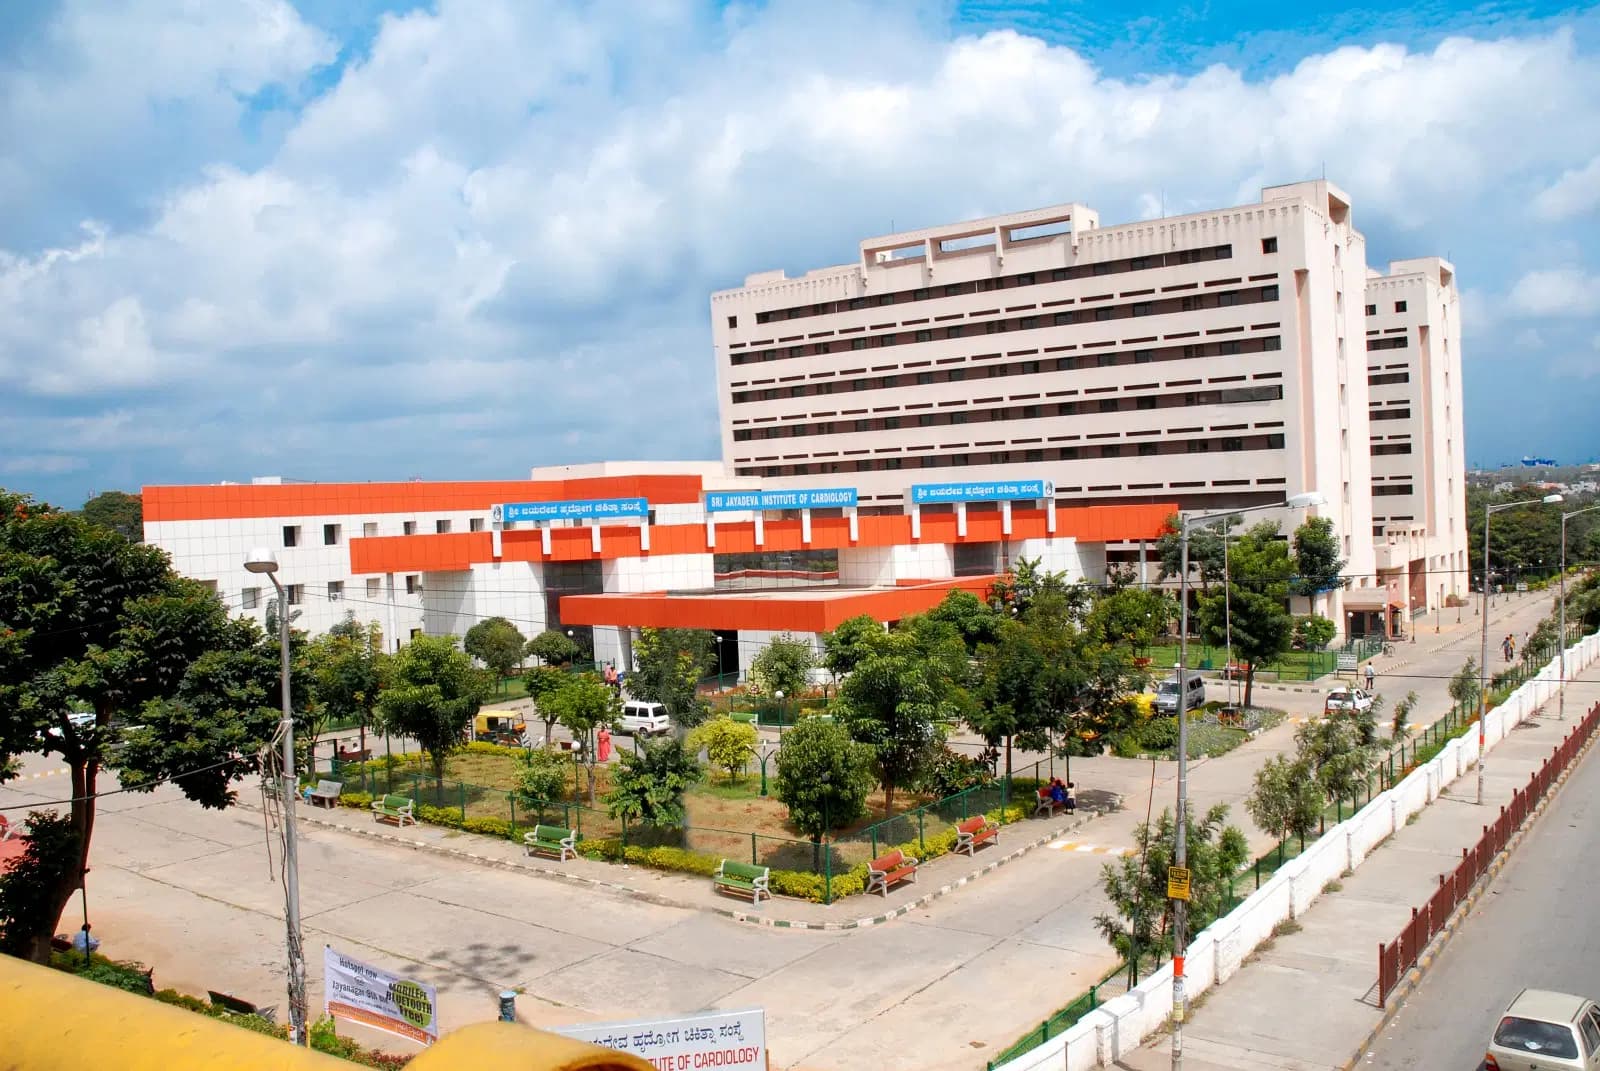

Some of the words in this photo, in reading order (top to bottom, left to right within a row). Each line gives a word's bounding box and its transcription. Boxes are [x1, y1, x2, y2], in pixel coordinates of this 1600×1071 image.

[712, 496, 723, 508] SRI
[726, 495, 759, 507] JAYADEVA
[761, 493, 797, 506] INSTITUTE
[800, 493, 808, 503] OF
[811, 491, 853, 503] CARDIOLOGY
[386, 991, 433, 1014] BLUETOOTH
[677, 1054, 691, 1070] OF
[694, 1047, 760, 1068] CARDIOLOGY
